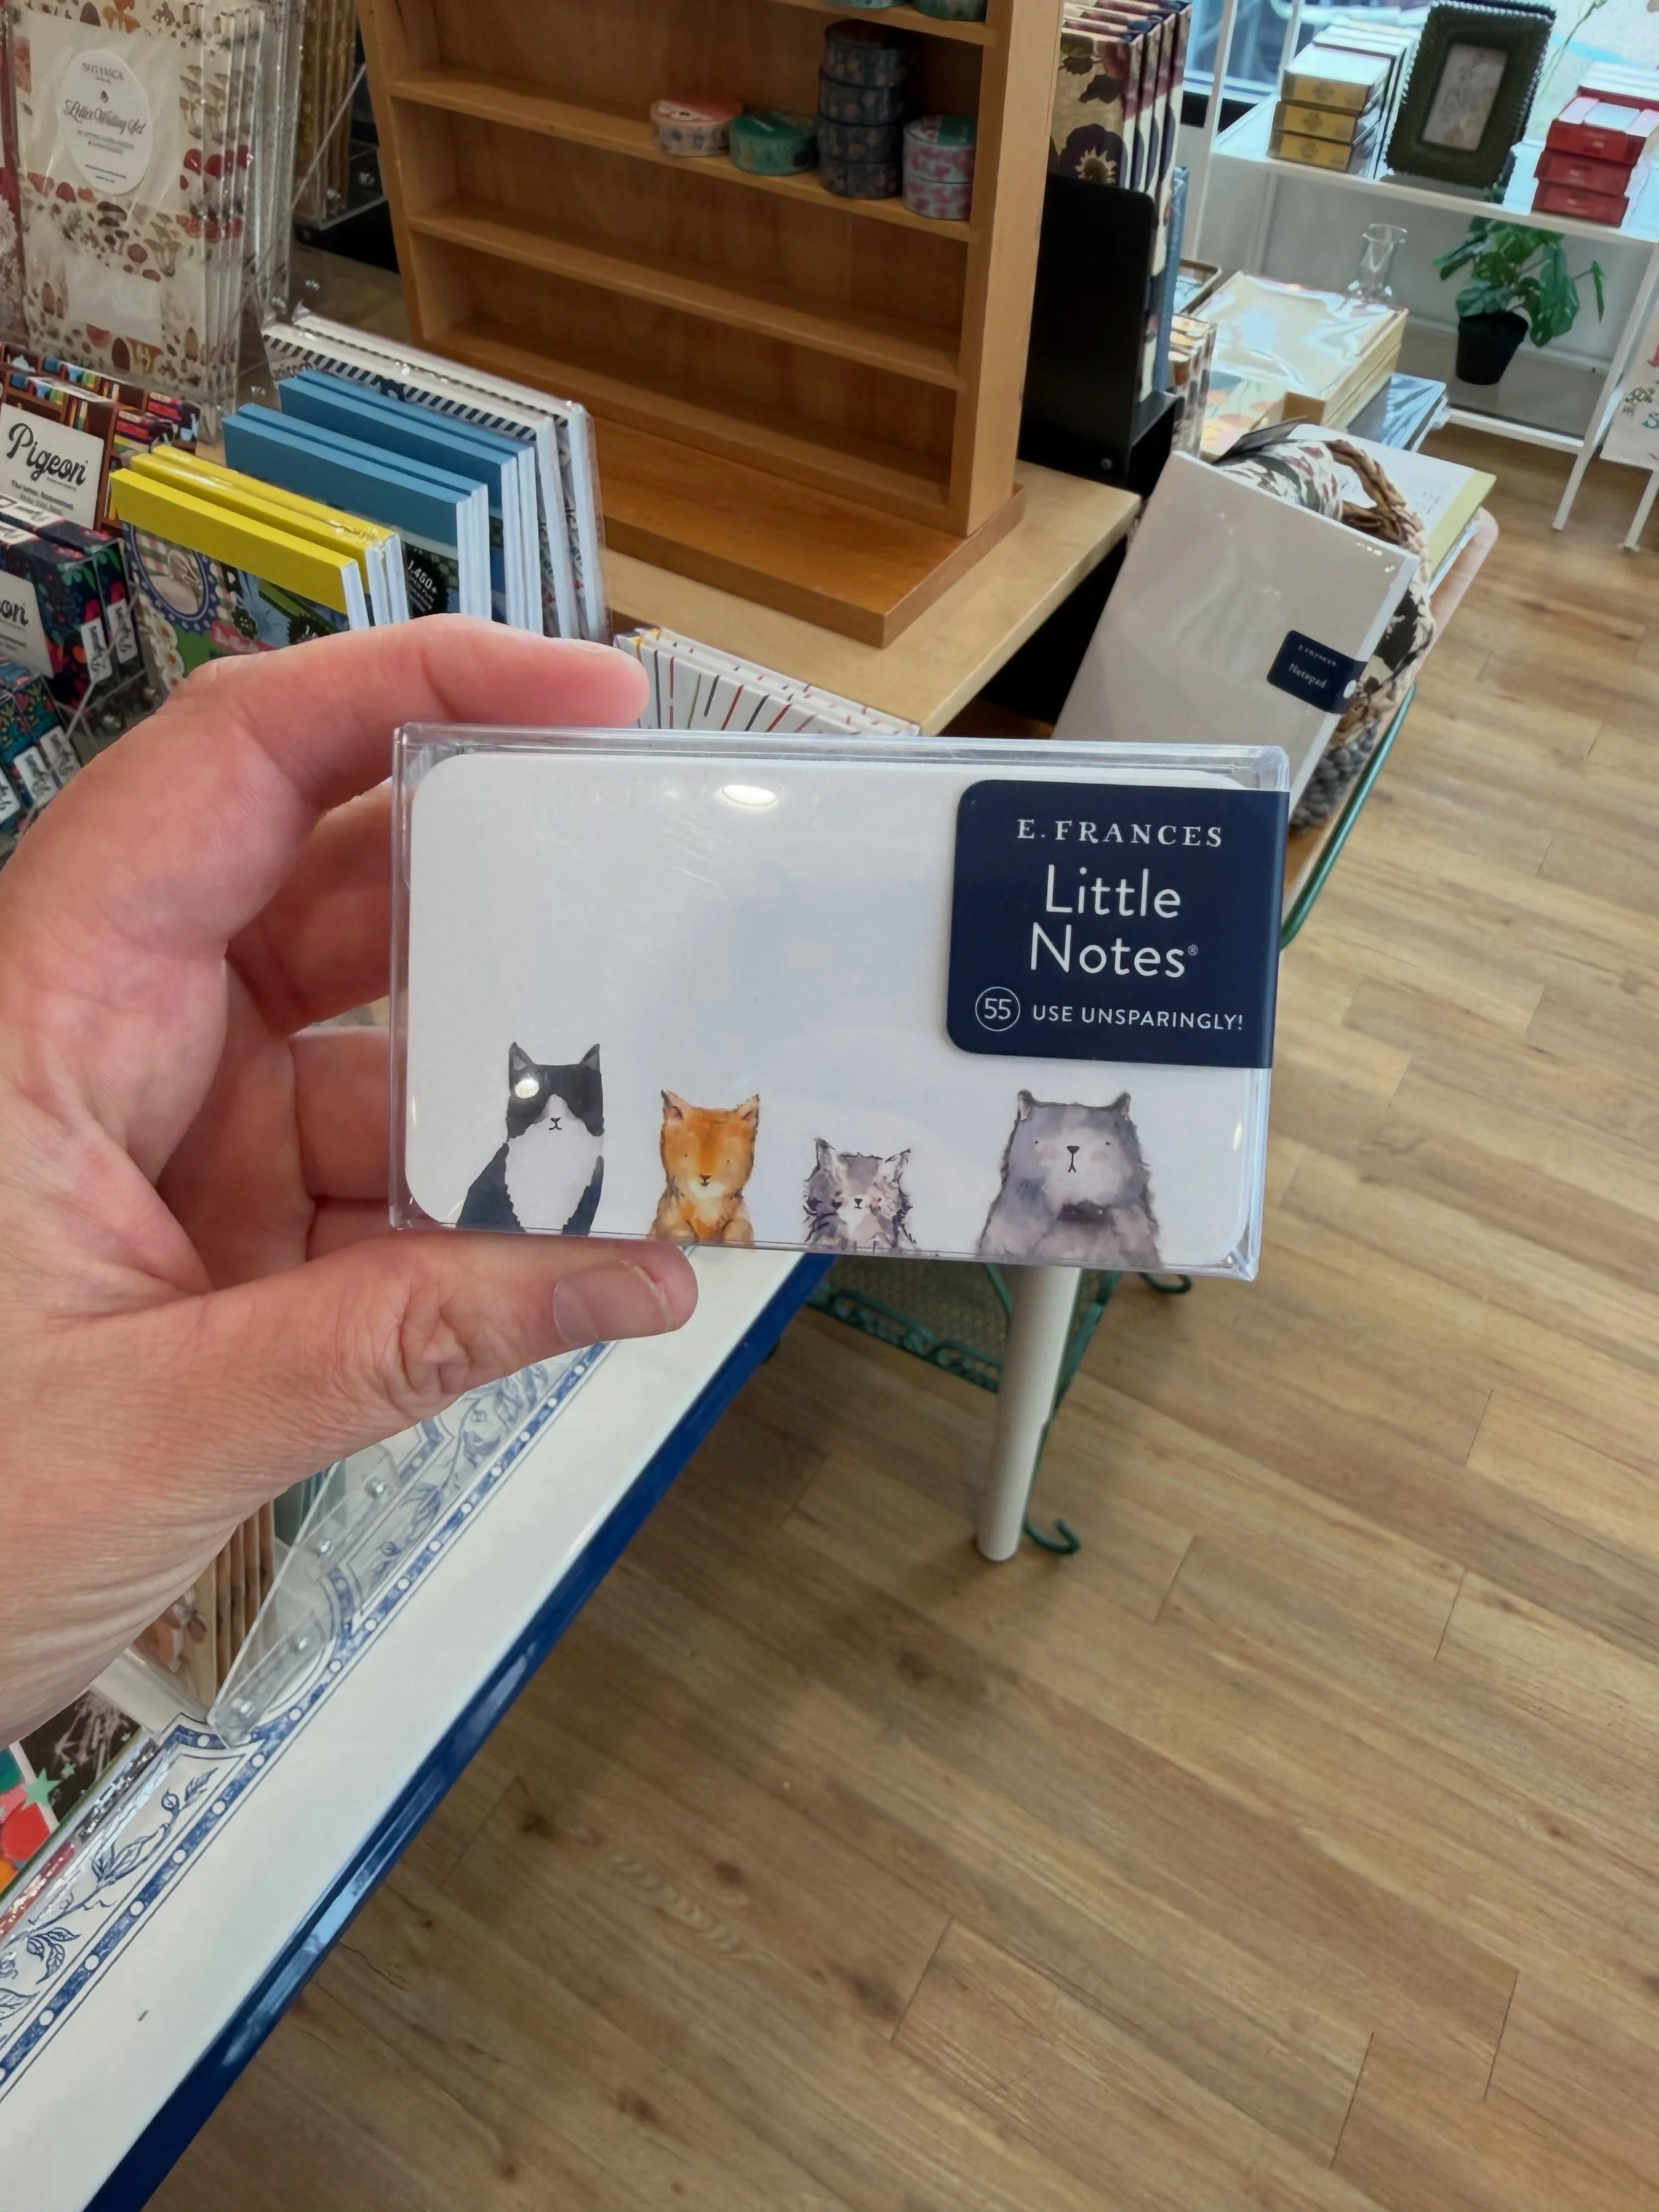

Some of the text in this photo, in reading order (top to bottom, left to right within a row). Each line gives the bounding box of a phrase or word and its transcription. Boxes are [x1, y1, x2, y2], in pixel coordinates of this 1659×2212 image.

[6, 423, 86, 486] Pigeon
[1289, 662, 1327, 689] Notepad
[1046, 864, 1181, 919] Little
[983, 997, 1243, 1031] 55 USE UNSPARINGLY!
